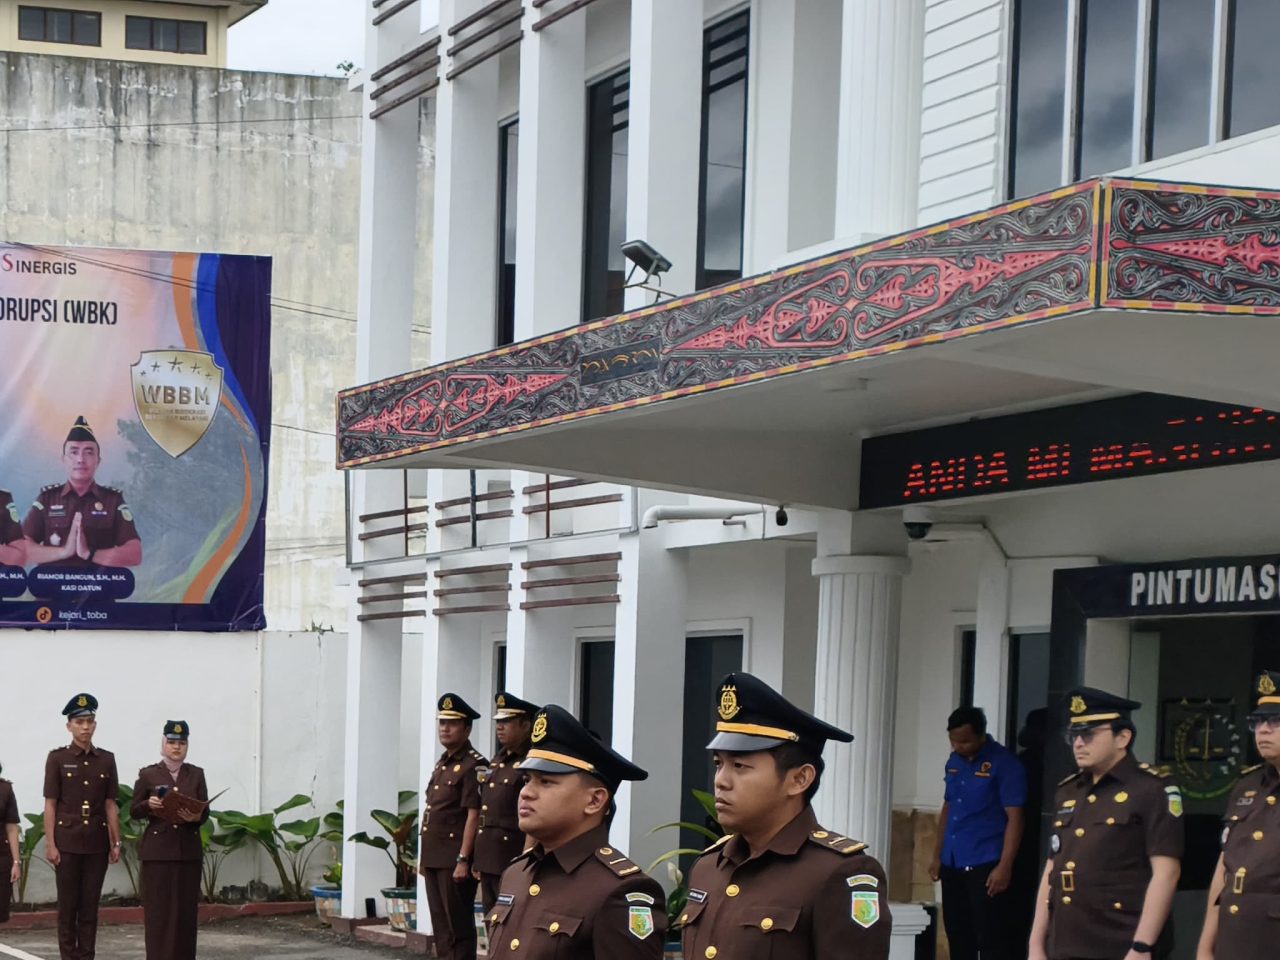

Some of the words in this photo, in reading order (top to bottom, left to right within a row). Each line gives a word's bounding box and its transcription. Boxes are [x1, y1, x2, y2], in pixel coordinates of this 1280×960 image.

[2, 253, 77, 275] SINERGIS
[64, 300, 118, 325] (WBK)
[141, 384, 210, 405] WBBM
[58, 610, 108, 621] kejari_toba
